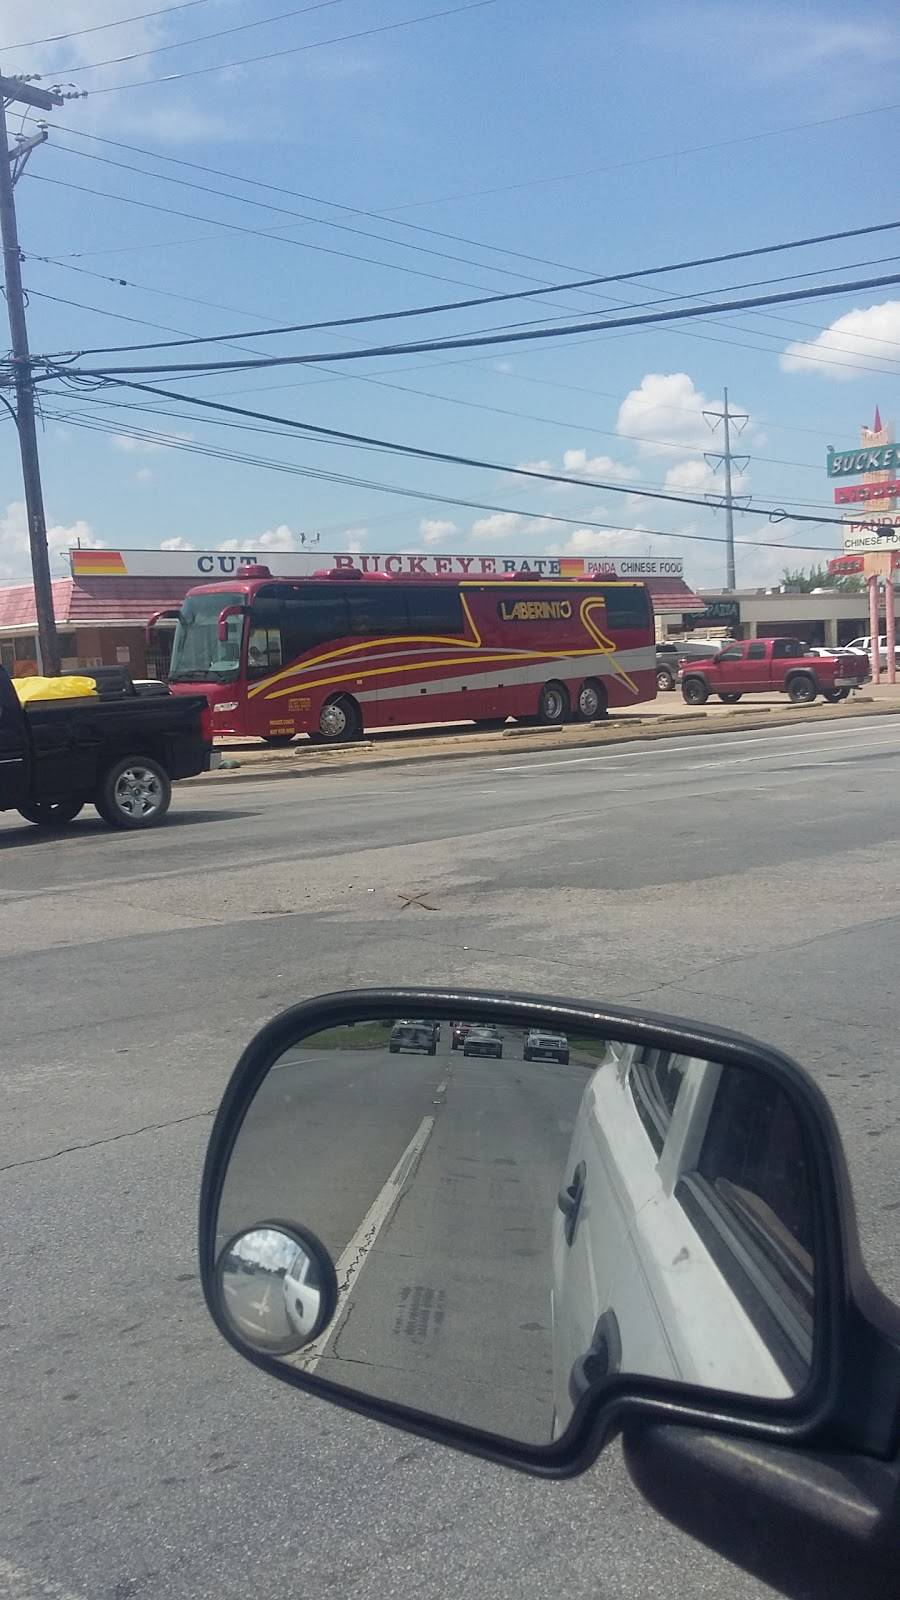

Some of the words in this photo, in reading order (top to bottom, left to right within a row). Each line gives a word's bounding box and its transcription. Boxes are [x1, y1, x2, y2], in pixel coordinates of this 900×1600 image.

[844, 536, 882, 548] CHINESE
[333, 556, 496, 573] BUCKEYE
[502, 560, 561, 575] RATE
[587, 562, 616, 572] PANDA
[620, 562, 657, 573] CHINESE
[659, 562, 683, 573] FOOD
[500, 600, 572, 620] LABERINTO
